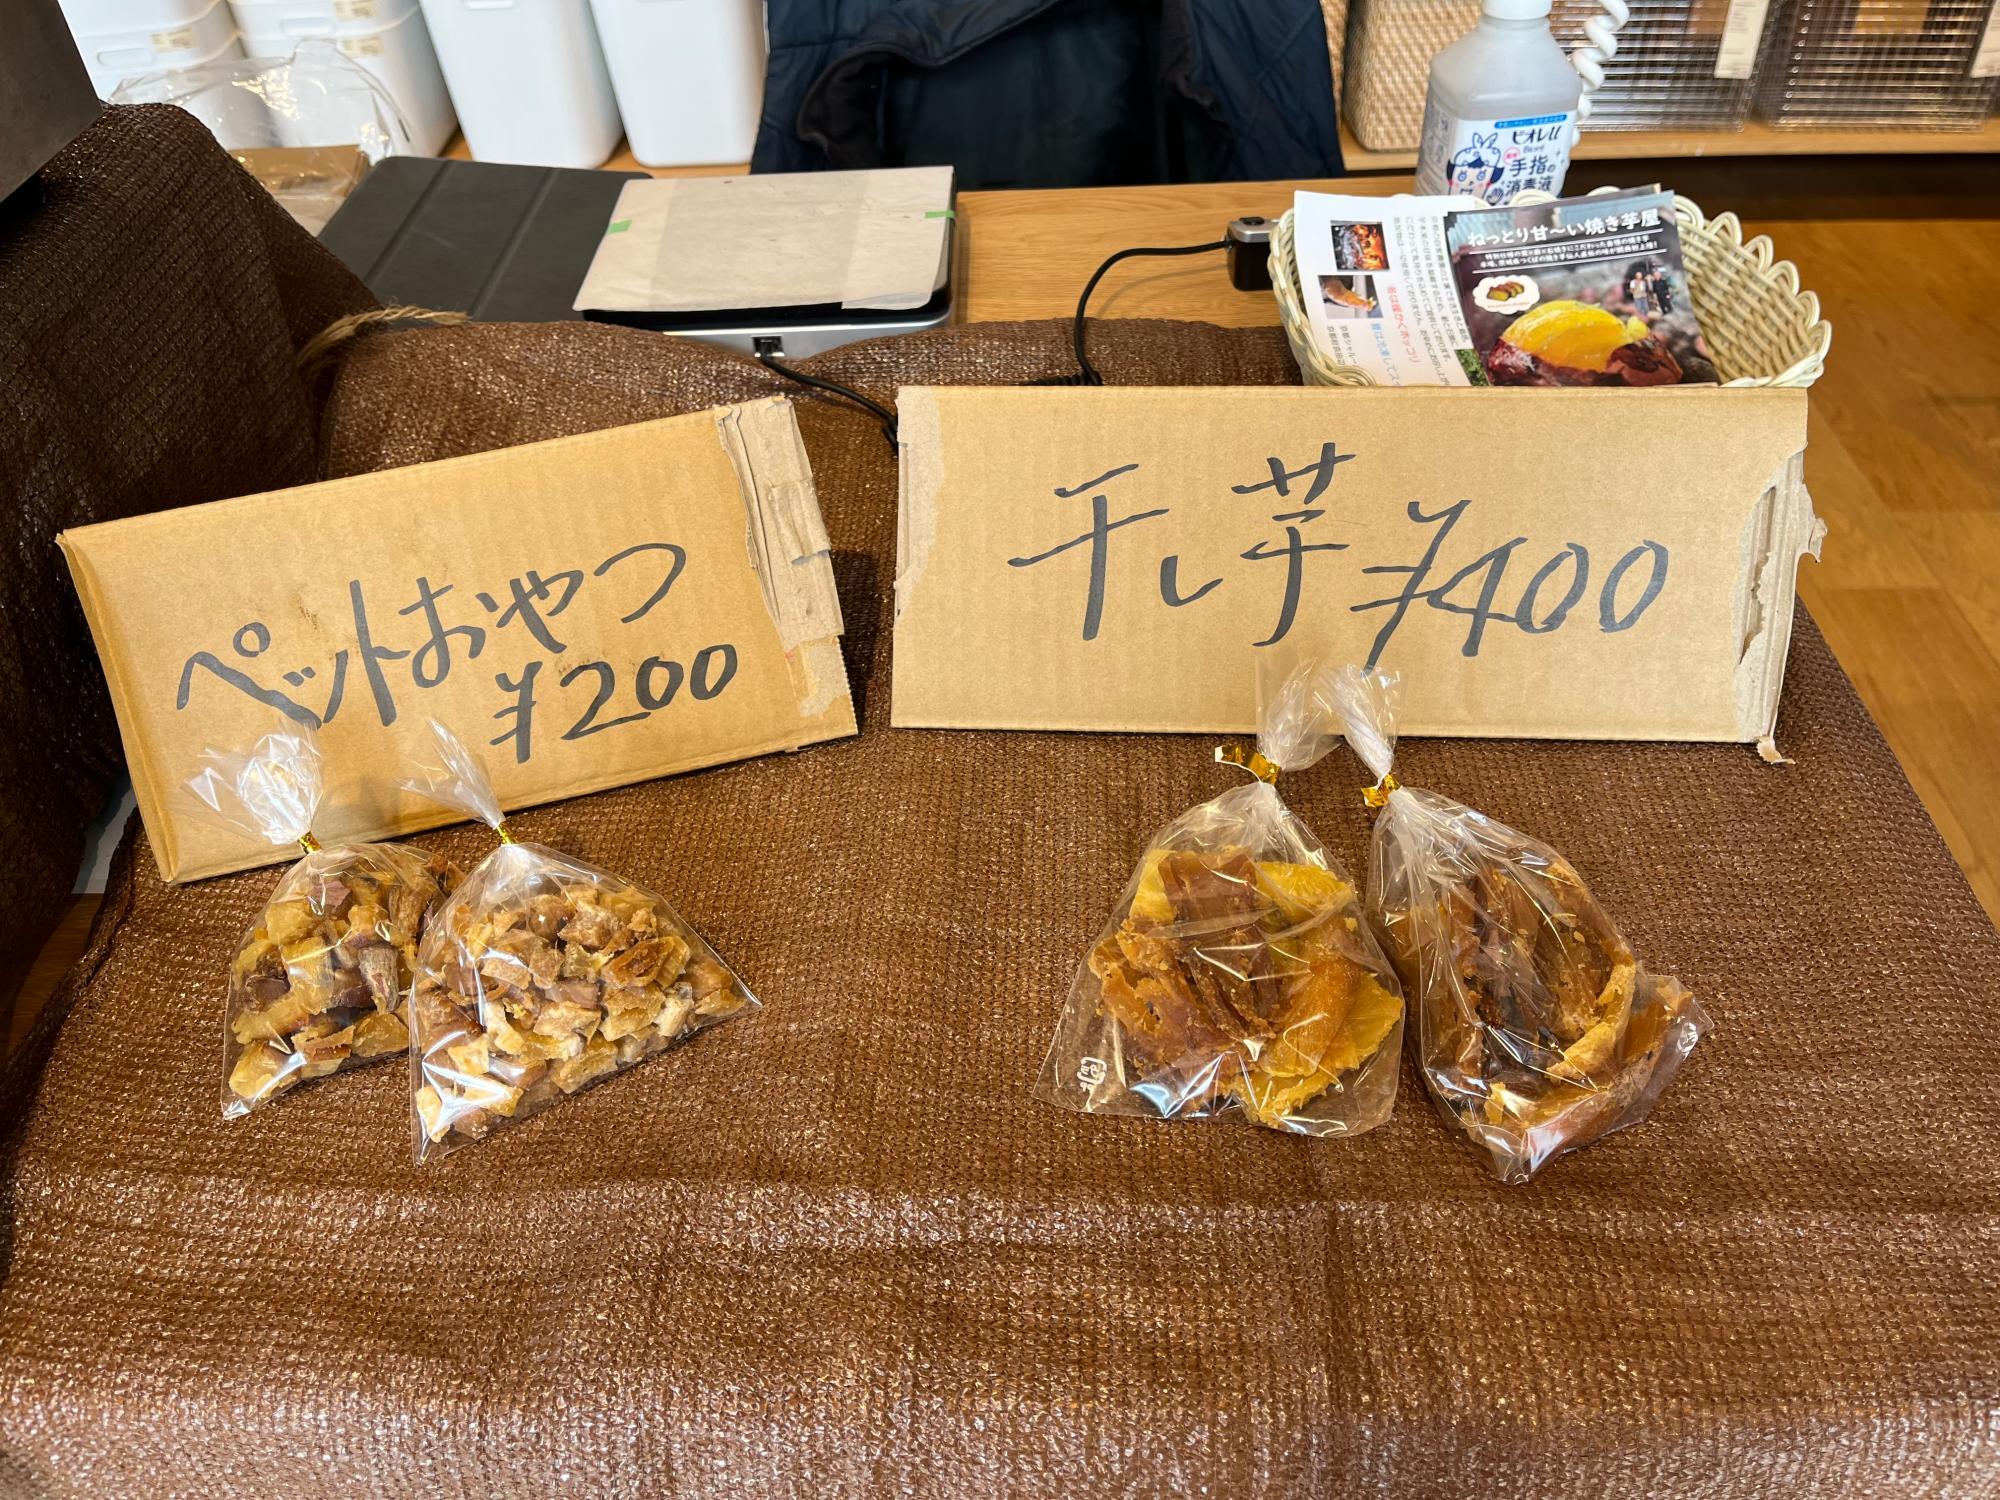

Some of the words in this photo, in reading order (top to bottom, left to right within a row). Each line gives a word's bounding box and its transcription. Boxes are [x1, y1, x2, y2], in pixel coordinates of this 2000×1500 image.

[1509, 155, 1556, 177] 手指の
[175, 542, 687, 730] ペットおやつ
[489, 643, 738, 764] ¥200
